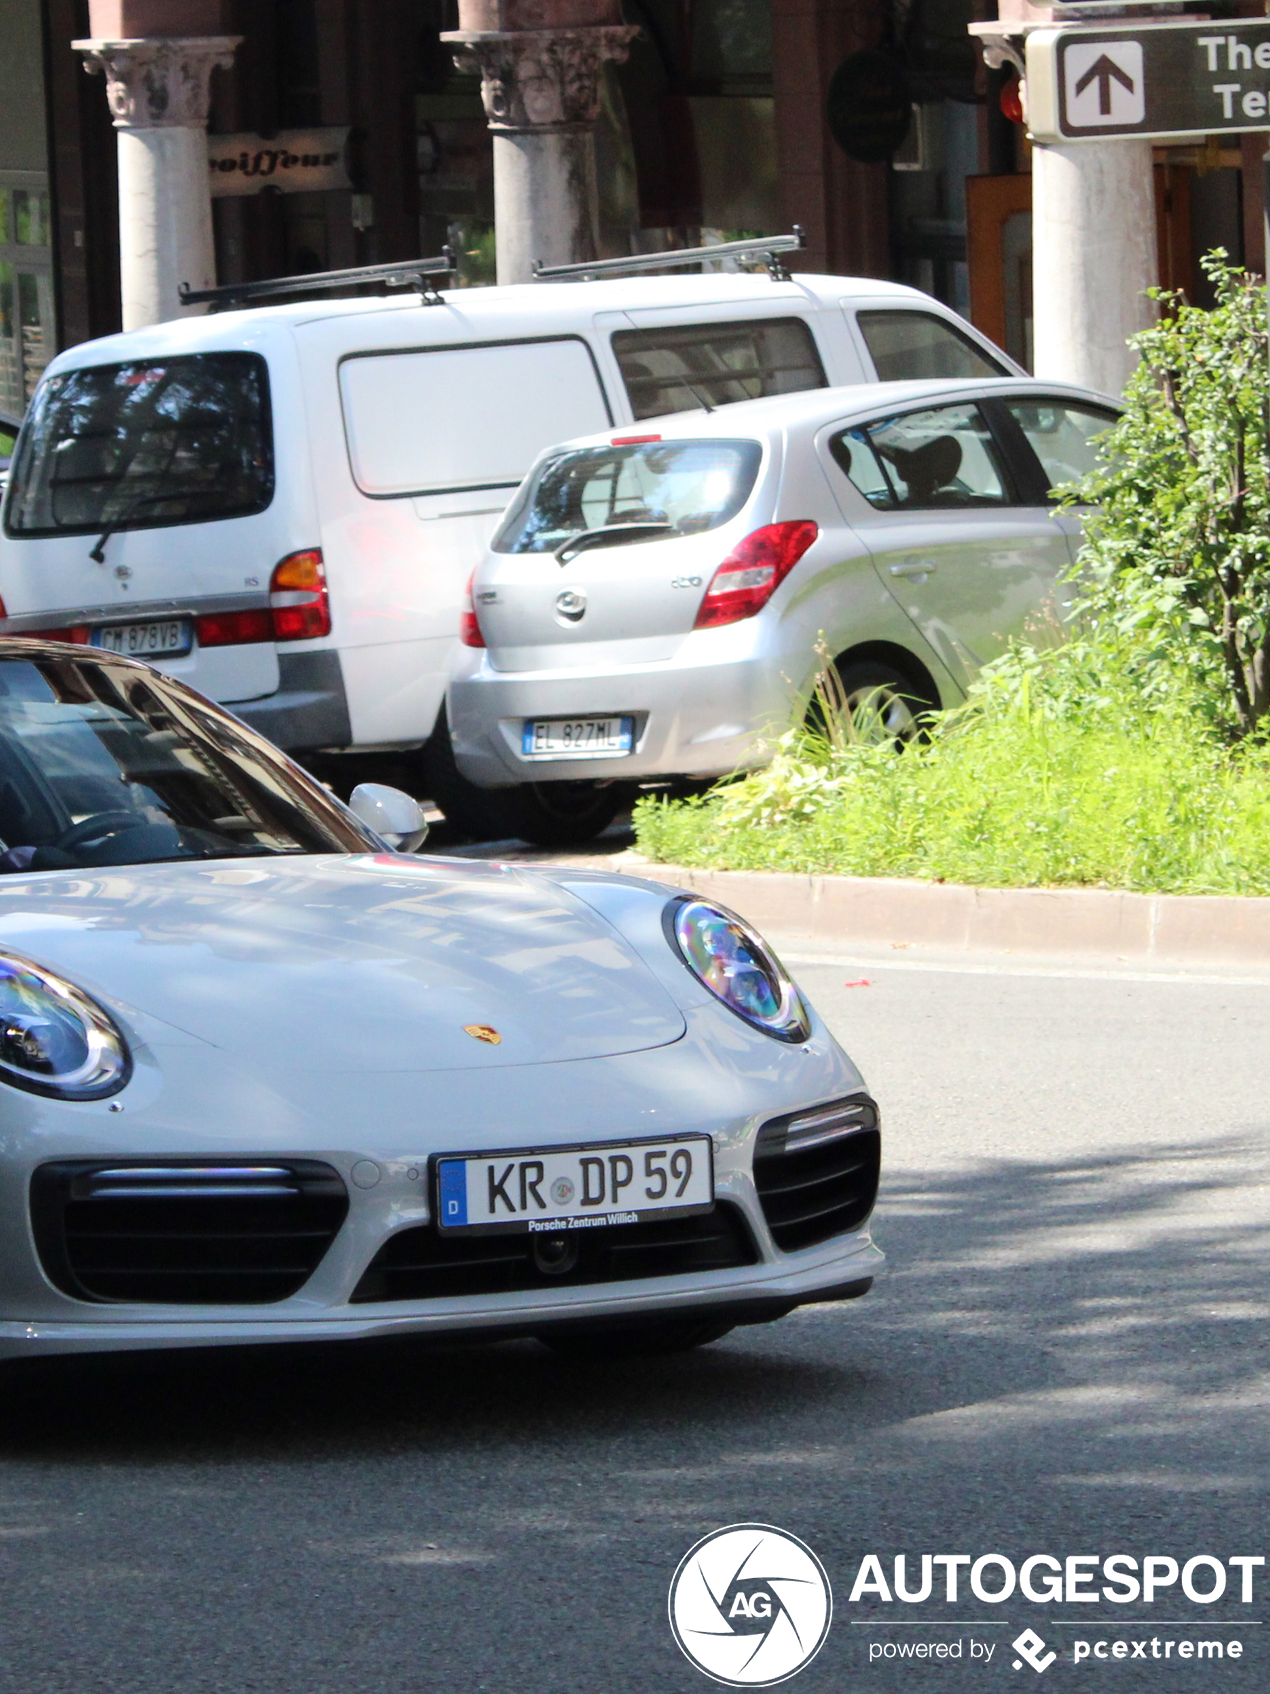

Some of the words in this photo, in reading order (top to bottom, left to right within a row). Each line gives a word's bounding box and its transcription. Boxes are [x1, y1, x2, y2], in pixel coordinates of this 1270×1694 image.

[1197, 35, 1270, 71] The
[1212, 83, 1270, 119] Te
[129, 623, 178, 650] 878VB
[534, 724, 554, 750] EL
[563, 721, 616, 747] 827ML
[448, 1200, 459, 1215] D
[487, 1160, 547, 1214] KR
[579, 1154, 634, 1207] DP
[644, 1148, 693, 1200] 59
[528, 1218, 567, 1232] Porsche
[568, 1216, 607, 1229] Zentrum
[607, 1211, 639, 1225] Willich
